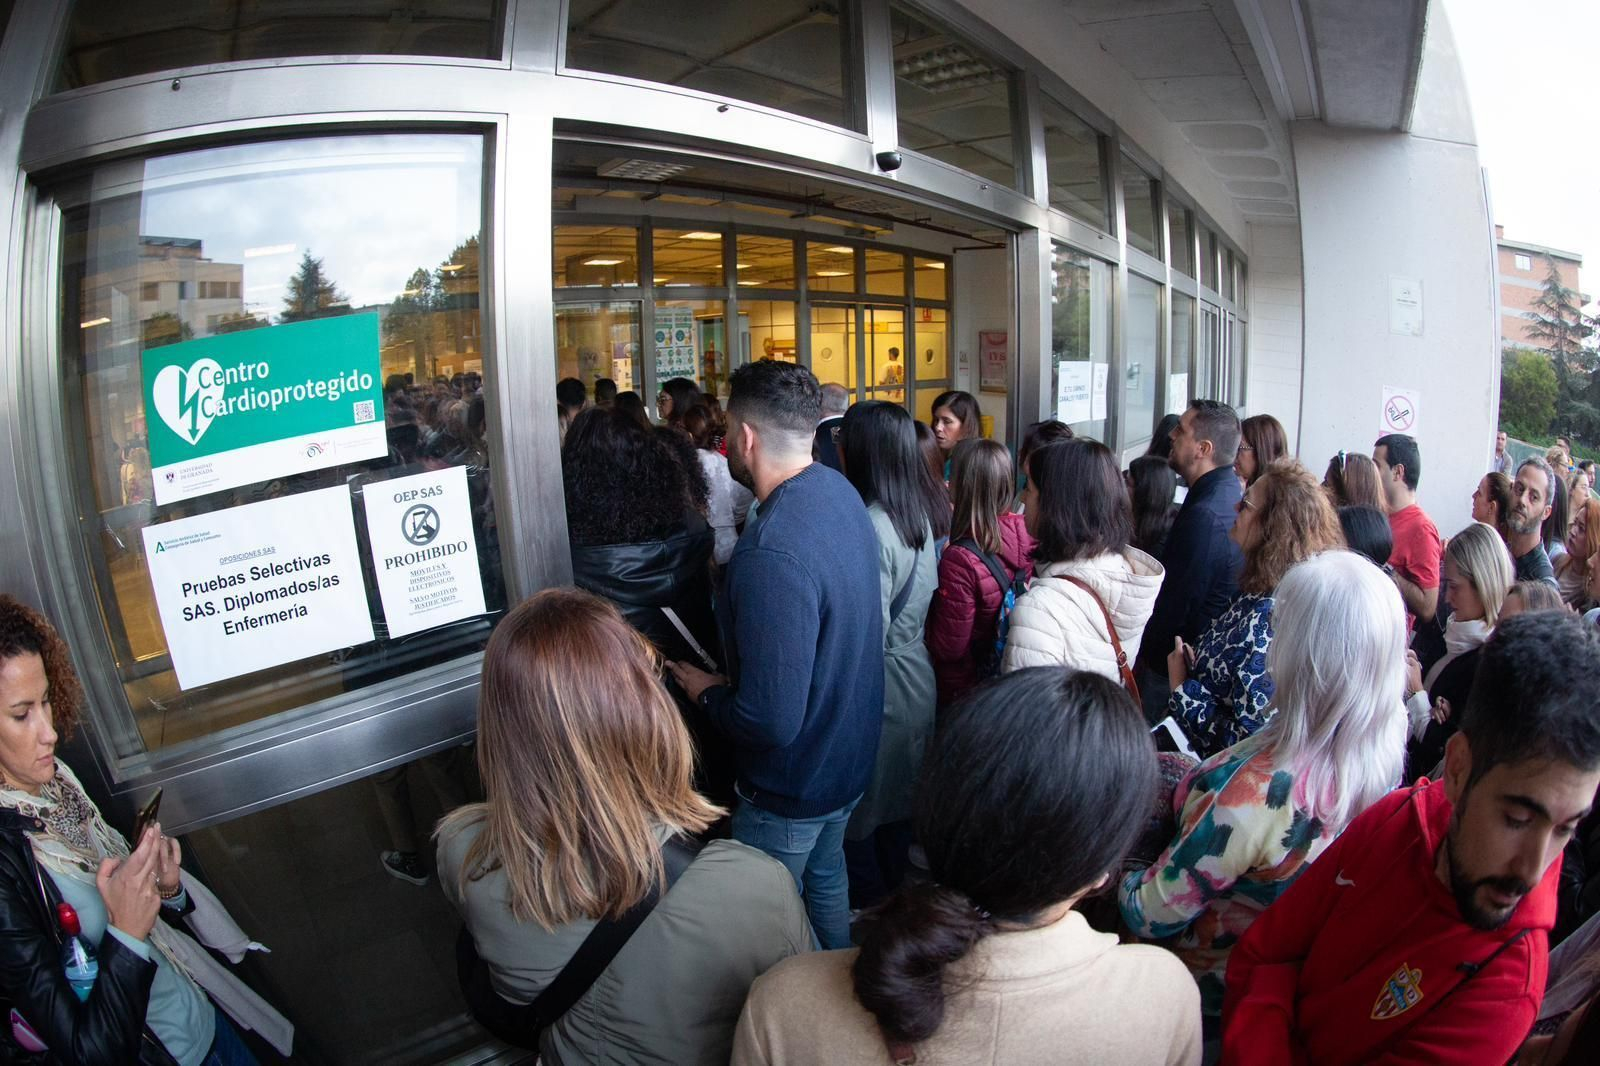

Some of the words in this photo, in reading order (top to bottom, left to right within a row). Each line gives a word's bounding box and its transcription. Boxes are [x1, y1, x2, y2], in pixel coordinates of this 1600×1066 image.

[198, 361, 270, 389] Centro
[201, 369, 373, 419] Cardioprotegido
[393, 490, 418, 503] OEP
[420, 485, 443, 498] SAS
[219, 549, 262, 565] OPOSICIONES
[262, 546, 276, 555] SAS
[384, 541, 468, 570] PROHIBIDO
[181, 567, 246, 598] Pruebas
[249, 552, 332, 581] Selectivas
[182, 605, 220, 622] SAS.
[223, 573, 340, 612] Diplomados/as
[223, 604, 308, 636] Enfermería
